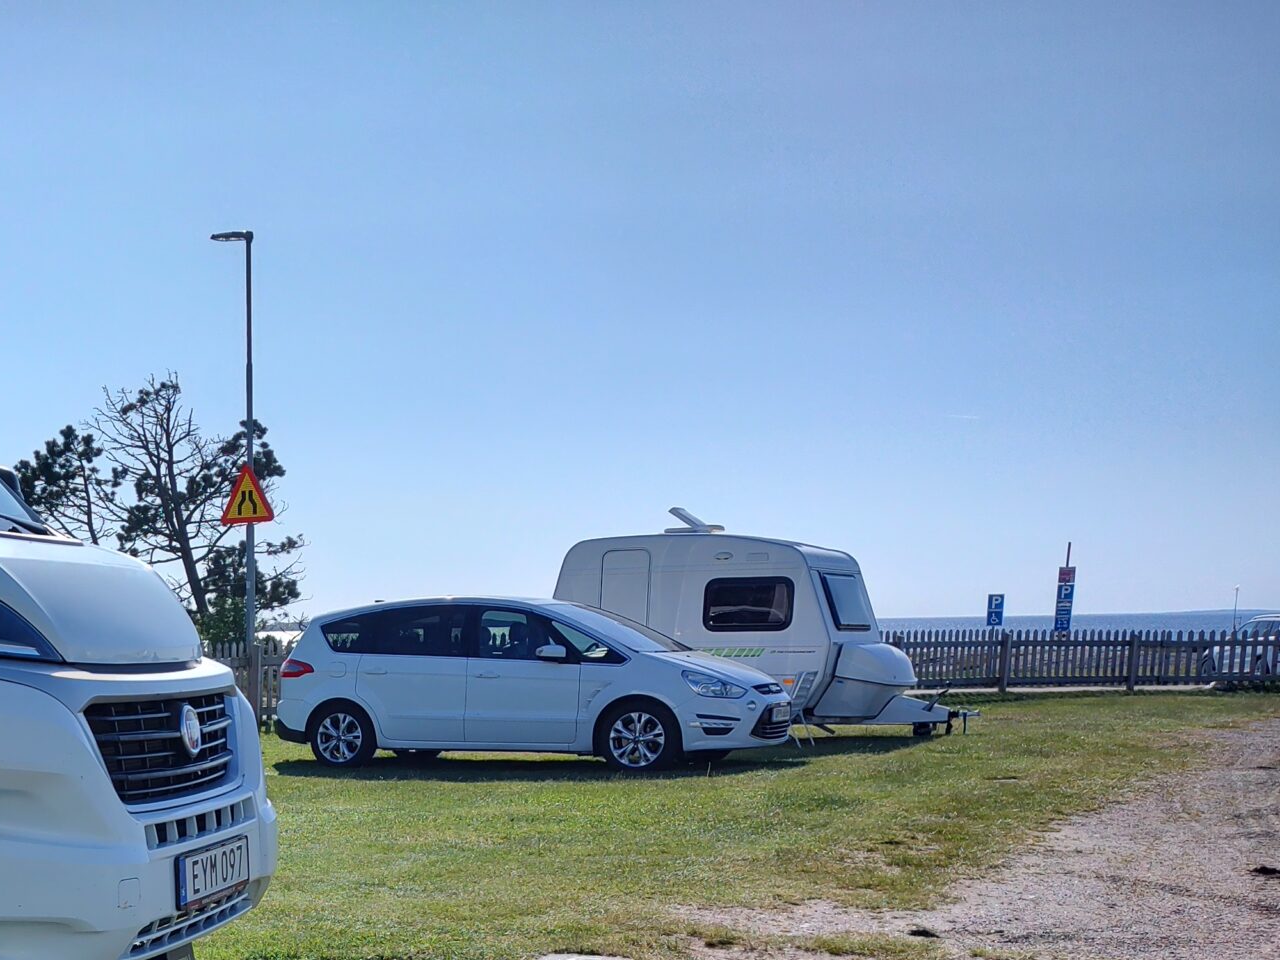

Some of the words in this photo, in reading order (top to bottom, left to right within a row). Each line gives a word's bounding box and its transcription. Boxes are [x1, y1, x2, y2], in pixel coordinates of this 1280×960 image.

[1061, 586, 1071, 599] P
[992, 596, 1002, 609] P
[192, 853, 218, 895] EYM
[221, 844, 243, 882] 097
